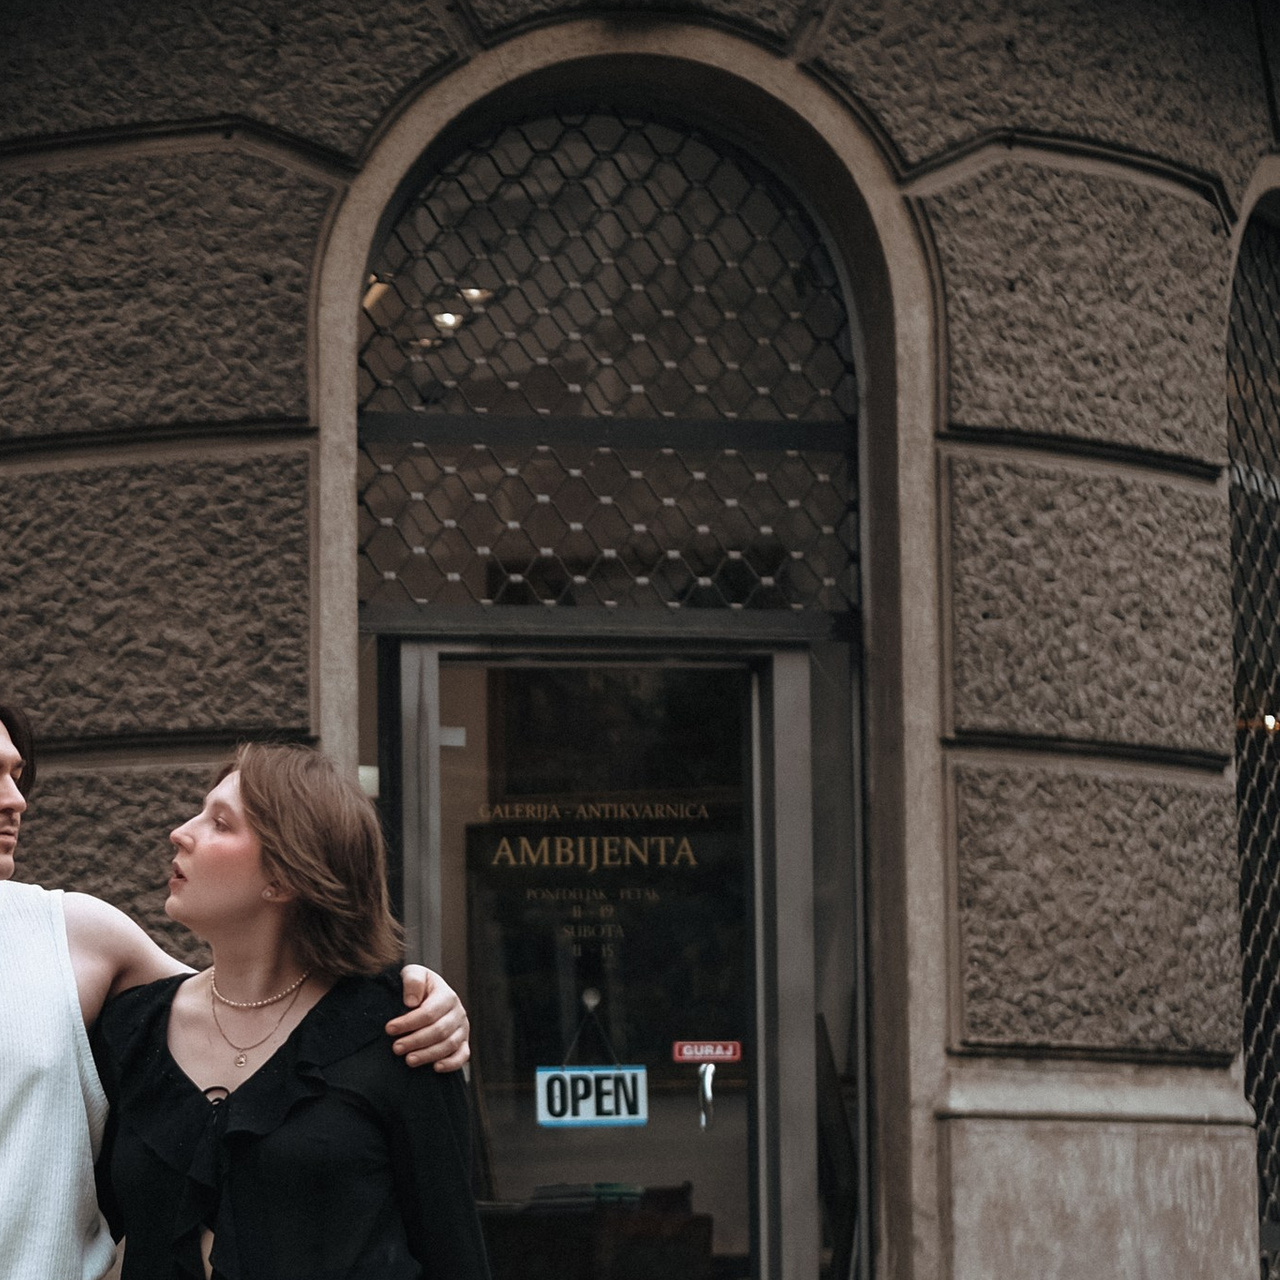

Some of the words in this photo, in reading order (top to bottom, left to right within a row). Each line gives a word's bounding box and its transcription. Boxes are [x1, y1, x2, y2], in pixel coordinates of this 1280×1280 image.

[477, 803, 560, 821] GALERIJA
[575, 802, 709, 819] ANTIKVARNICA
[492, 835, 698, 873] AMBIJENTA
[561, 924, 625, 938] SUBOTA
[683, 1044, 734, 1056] GURAJ
[546, 1073, 640, 1118] OPEN
